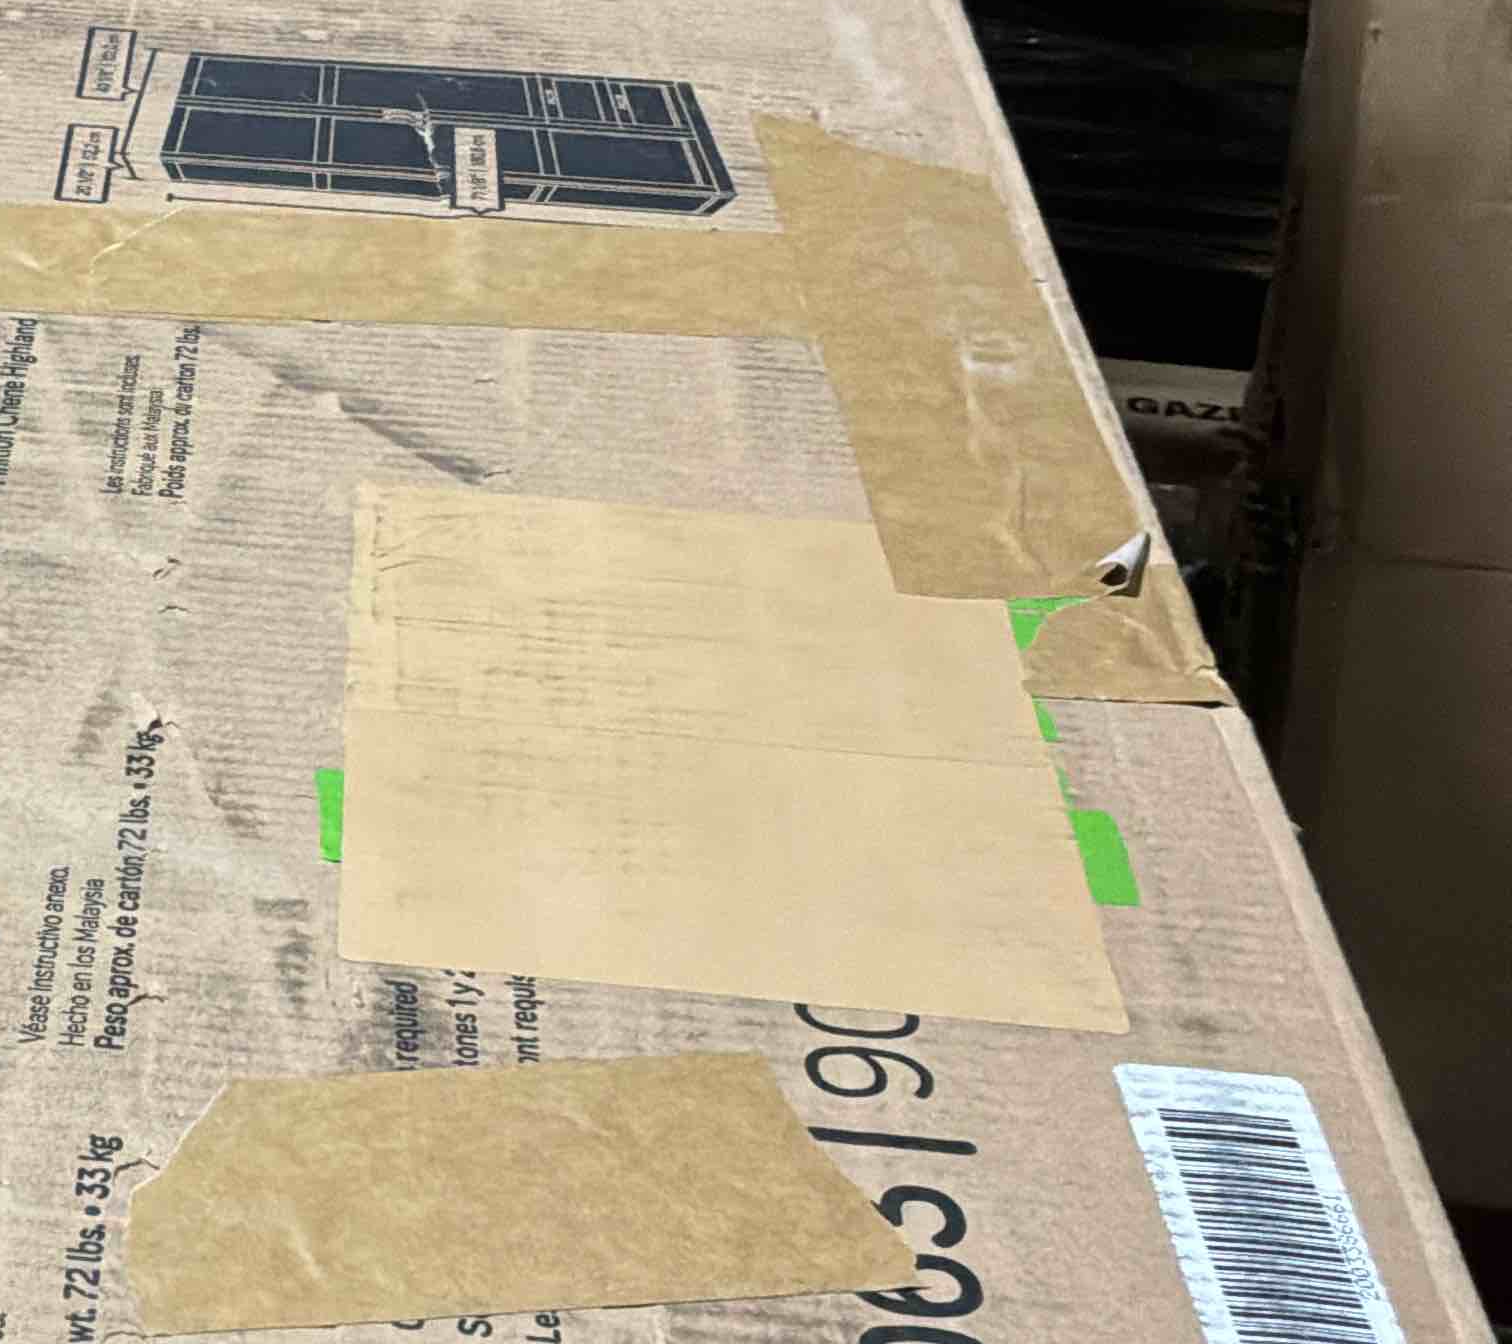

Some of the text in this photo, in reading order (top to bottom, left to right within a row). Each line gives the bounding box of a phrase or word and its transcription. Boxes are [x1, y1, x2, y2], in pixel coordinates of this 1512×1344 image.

[0, 318, 39, 377] Highland
[158, 465, 186, 499] Poids
[173, 345, 199, 361] 72
[126, 731, 164, 752] kg
[125, 754, 155, 779] 33
[117, 829, 146, 852] 72
[108, 916, 138, 938] de
[29, 915, 63, 992] instructivo
[58, 878, 107, 1047] Hecho en los Malaysia
[454, 982, 485, 998] y
[17, 995, 52, 1045] Véase
[94, 1003, 128, 1050] Peso
[385, 979, 426, 1063] required
[78, 1134, 123, 1163] kg
[74, 1168, 112, 1200] 33
[64, 1224, 106, 1263] lbs.
[62, 1268, 101, 1300] 72
[69, 1308, 97, 1343] wt.
